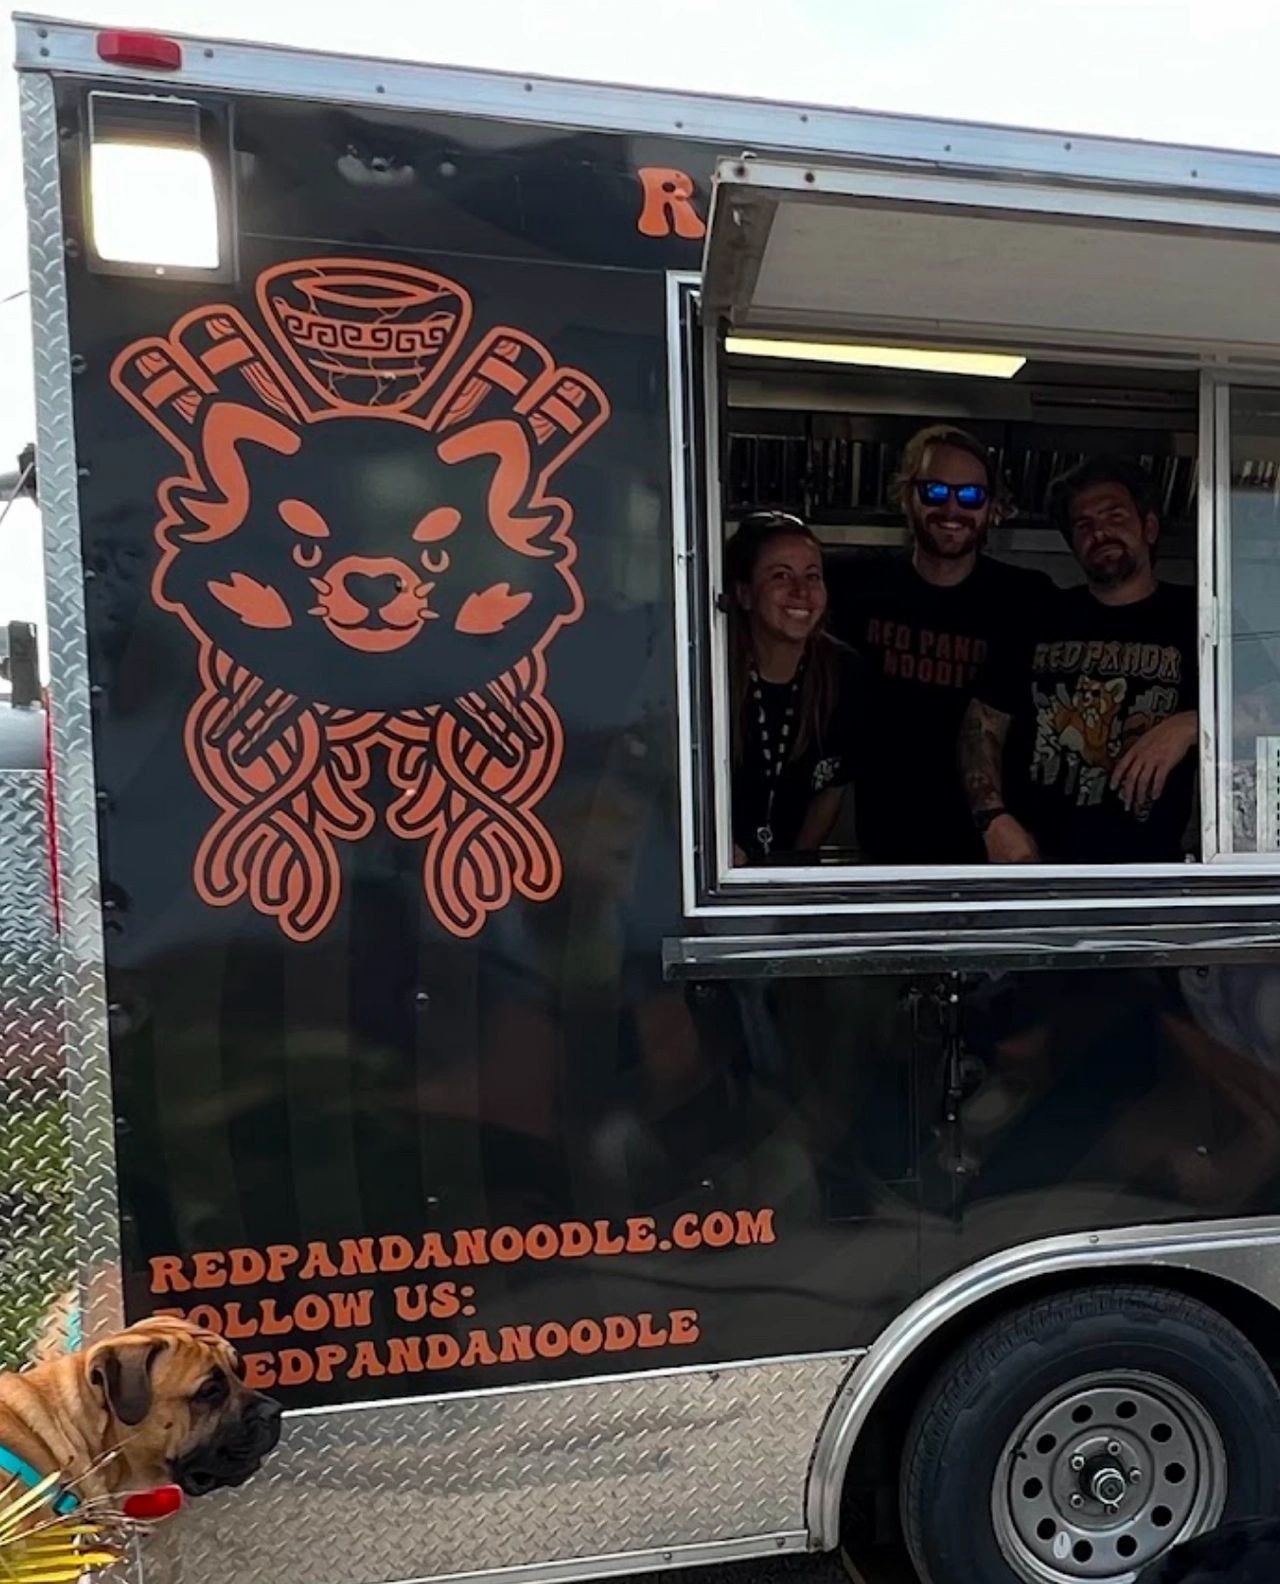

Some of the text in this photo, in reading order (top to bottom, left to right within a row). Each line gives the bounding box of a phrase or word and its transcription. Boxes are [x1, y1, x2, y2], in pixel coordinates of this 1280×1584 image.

[867, 618, 911, 650] RED
[1032, 640, 1182, 684] RED PANDA
[149, 1208, 776, 1294] REDPANDANOODLE.COM
[153, 1282, 476, 1338] OLLOW US:
[242, 1309, 700, 1389] EDPANDANOODLE
